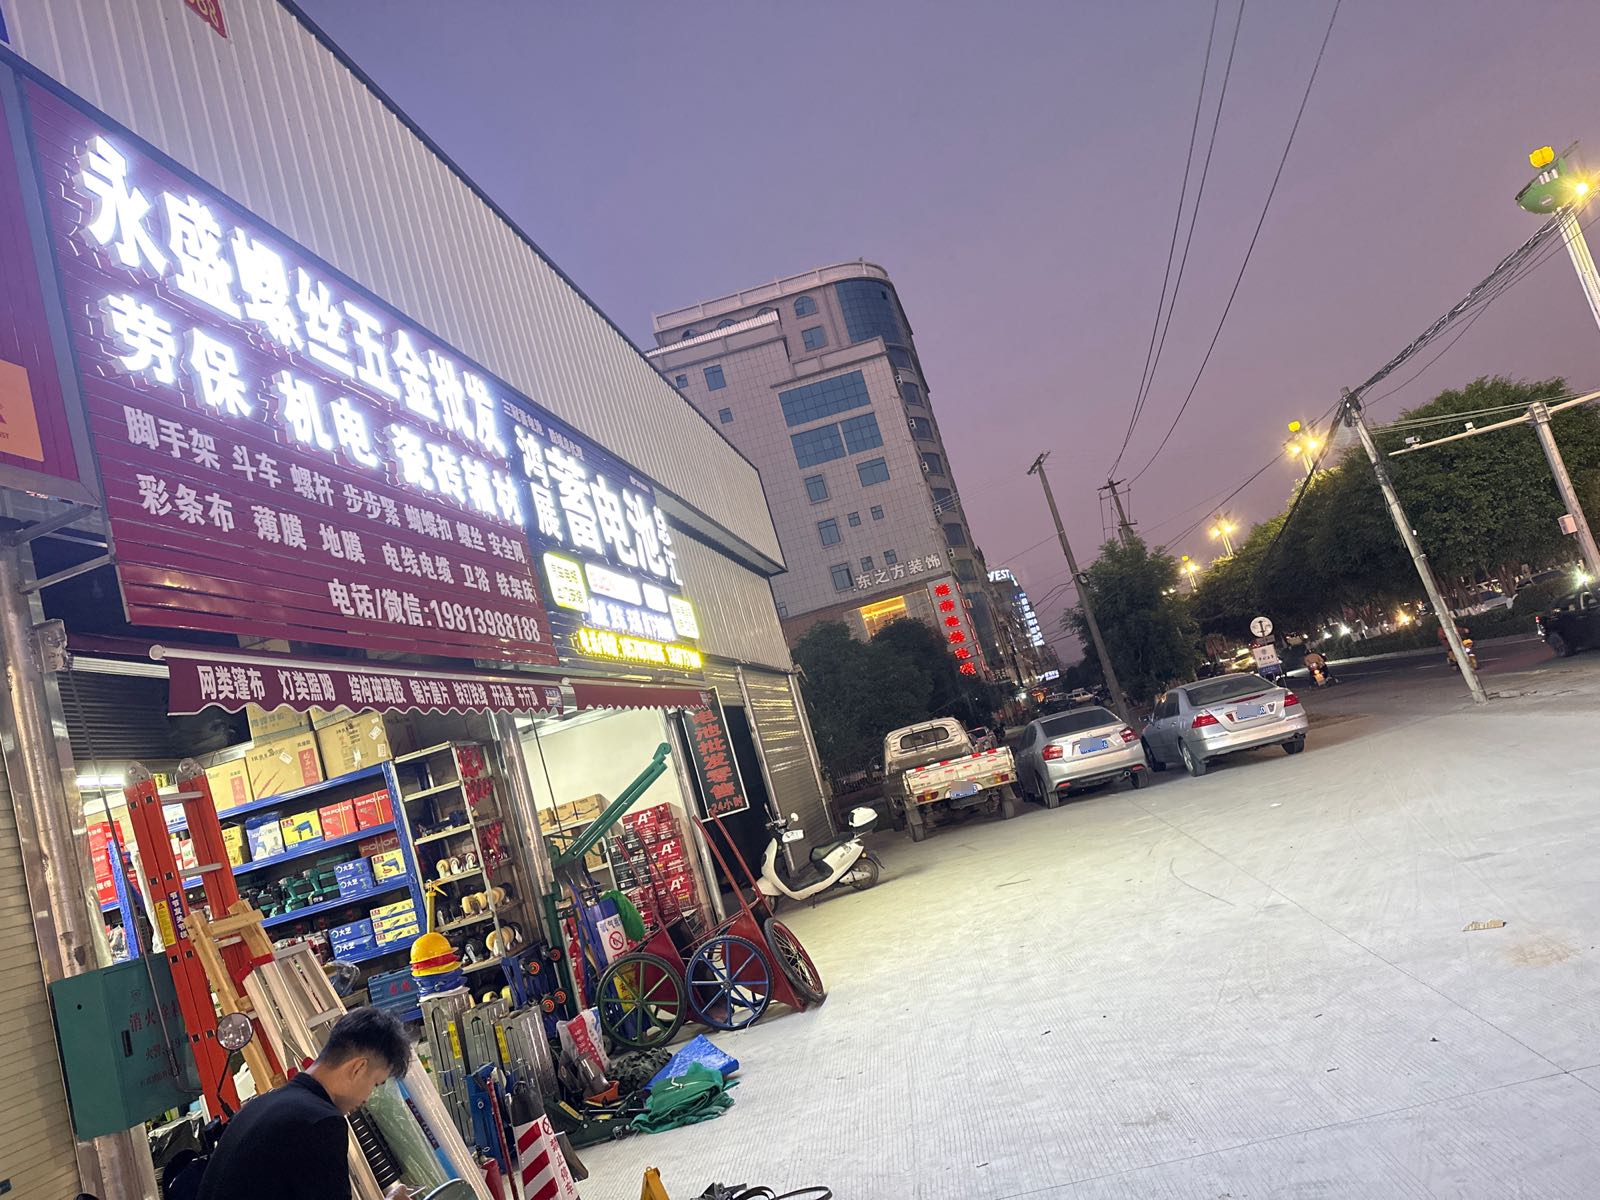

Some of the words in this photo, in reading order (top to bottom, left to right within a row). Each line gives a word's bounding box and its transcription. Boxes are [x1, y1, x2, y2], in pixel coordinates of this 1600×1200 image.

[78, 135, 507, 458] 永盛螺丝五金批发
[106, 293, 257, 419] 劳保
[274, 369, 382, 468] 机电
[386, 423, 526, 528] 瓷砖辅材
[123, 405, 222, 470] 脚手架
[232, 446, 282, 489] 斗车
[290, 463, 337, 508] 螺杆
[342, 483, 401, 528] 步步紧
[403, 502, 454, 543] 蝴蝶扣
[456, 519, 487, 554] 螺丝
[487, 530, 526, 565] 安全网
[135, 473, 235, 533] 彩条布
[250, 504, 308, 551] 薄膜
[319, 522, 367, 566] 地膜
[381, 541, 455, 585] 电线电缆
[459, 562, 490, 594] 卫浴
[496, 570, 537, 604] 铁架床
[544, 446, 668, 577] 蓄电池
[855, 554, 942, 590] 东之方装饰
[196, 664, 265, 701] 网类篷布
[277, 667, 336, 702] 灯类照明
[346, 673, 407, 705] 结构玻璃胶
[490, 682, 516, 707] 开孔器
[516, 685, 540, 707] 千斤顶
[549, 1137, 574, 1195] 禁止停车
